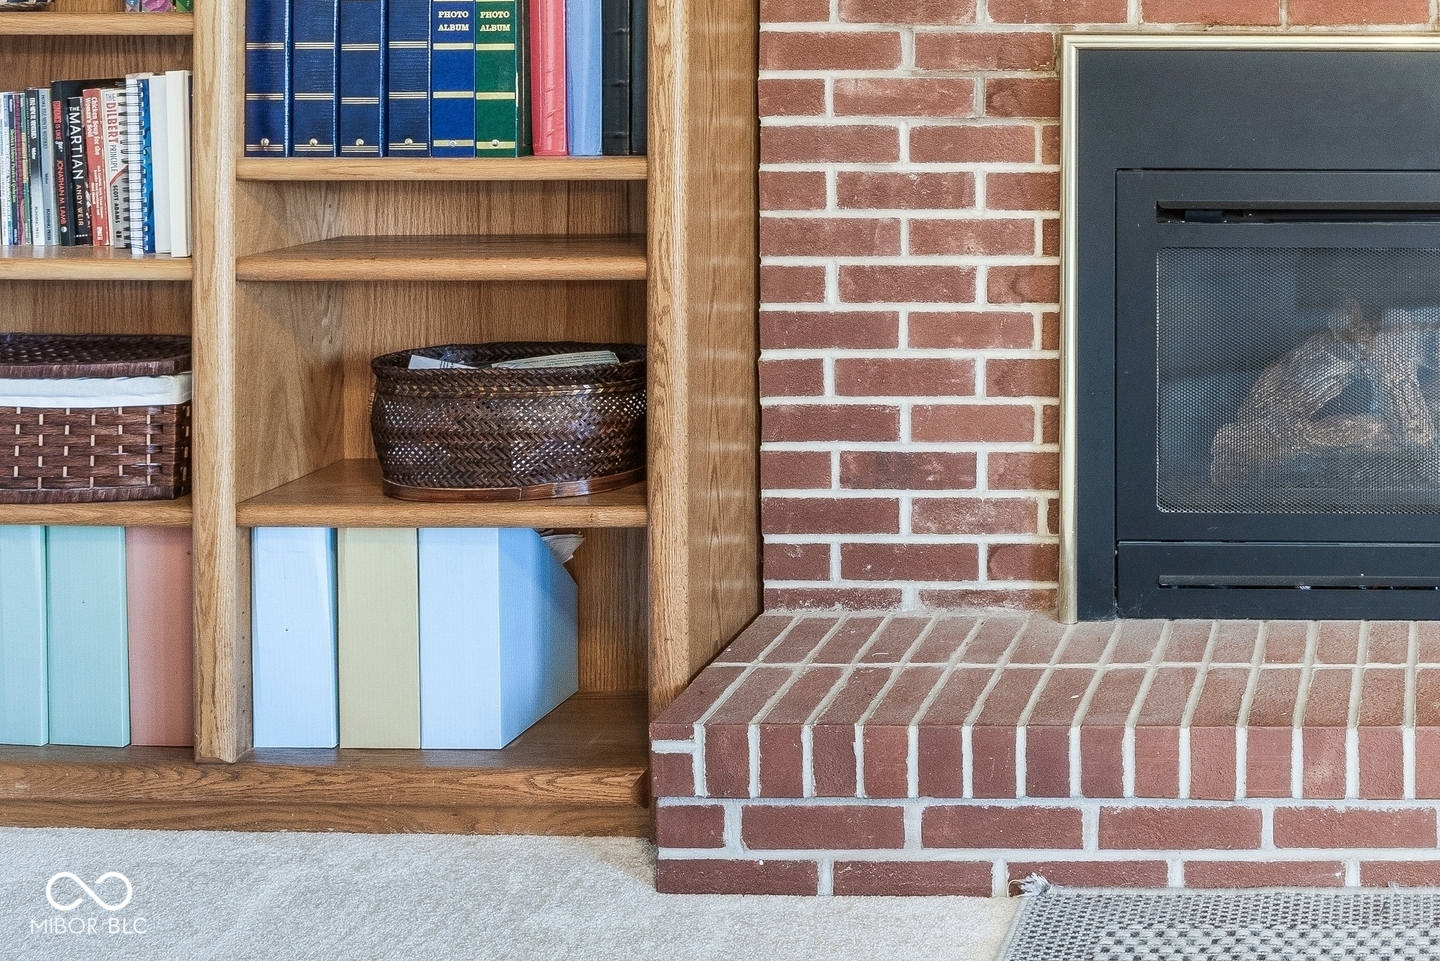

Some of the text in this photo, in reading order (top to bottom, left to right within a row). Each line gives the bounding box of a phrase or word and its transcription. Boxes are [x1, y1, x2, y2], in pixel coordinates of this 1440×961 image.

[438, 10, 469, 19] PHOTO
[480, 10, 510, 19] PHOTO
[438, 24, 470, 32] ALBUM
[480, 24, 510, 32] ALBUM
[106, 103, 118, 143] DILBERT
[69, 112, 84, 179] MARTIAN
[57, 160, 65, 196] JONATHAN
